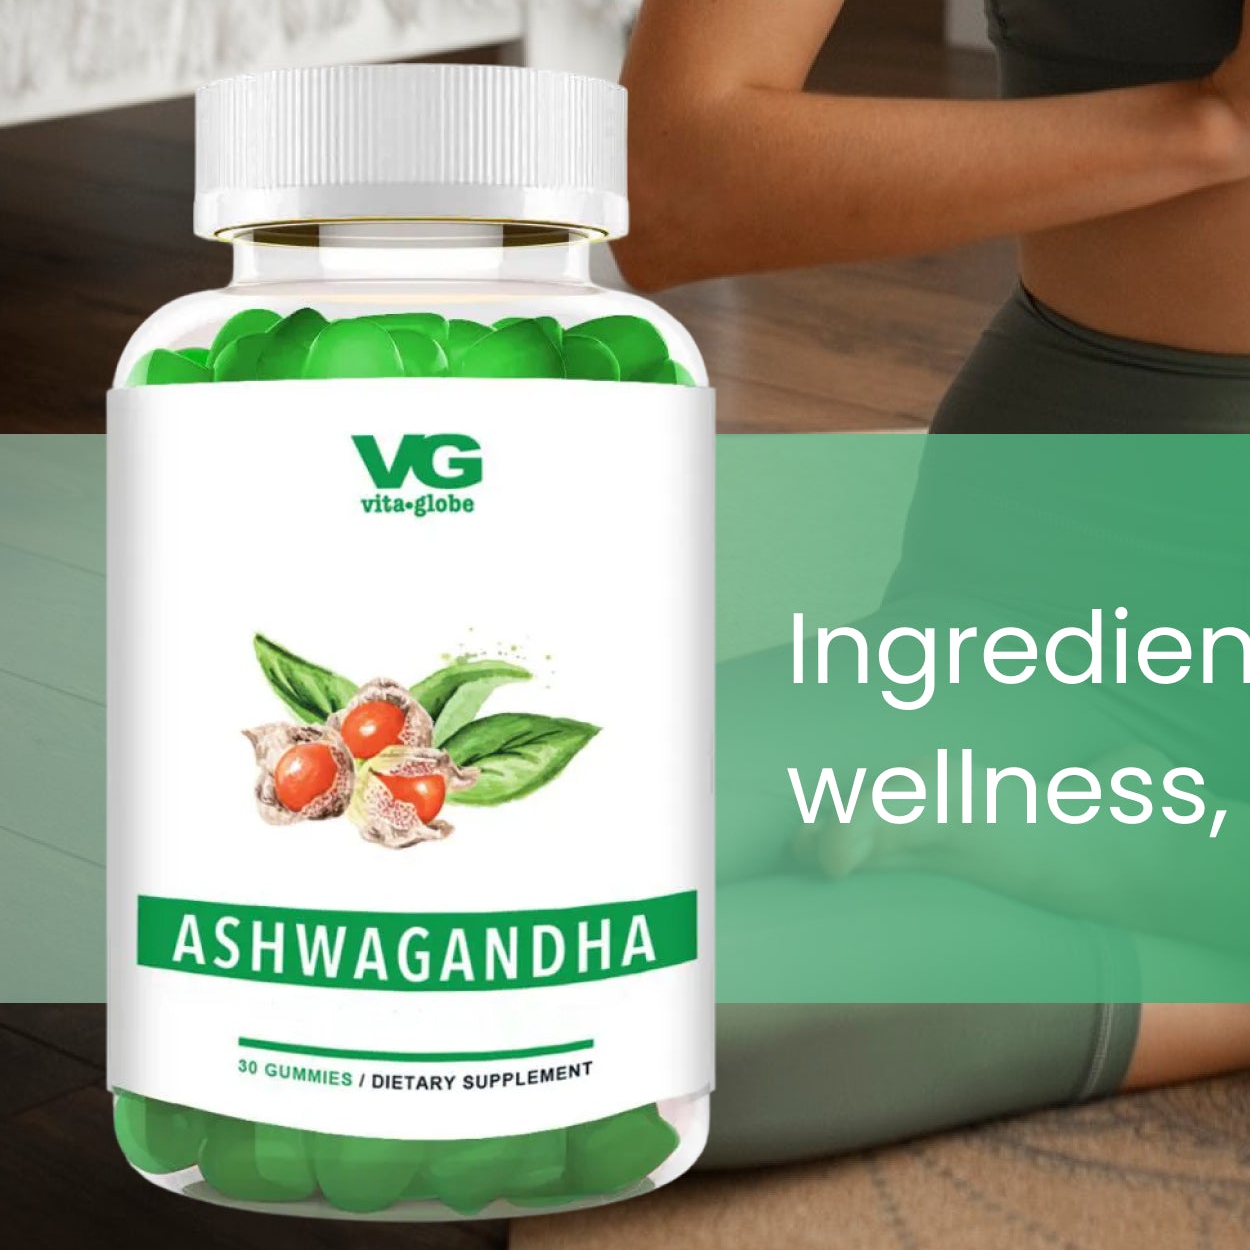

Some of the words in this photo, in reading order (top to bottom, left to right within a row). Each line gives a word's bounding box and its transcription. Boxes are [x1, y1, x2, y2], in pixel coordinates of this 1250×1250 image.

[351, 433, 483, 490] VG
[171, 913, 657, 983] ASHWAGANDHA
[238, 1058, 258, 1075] 30
[265, 1062, 354, 1087] GUMMIES
[358, 1073, 366, 1089] /
[371, 1073, 456, 1091] DIETARY
[462, 1060, 594, 1090] SUPPLEMENT
